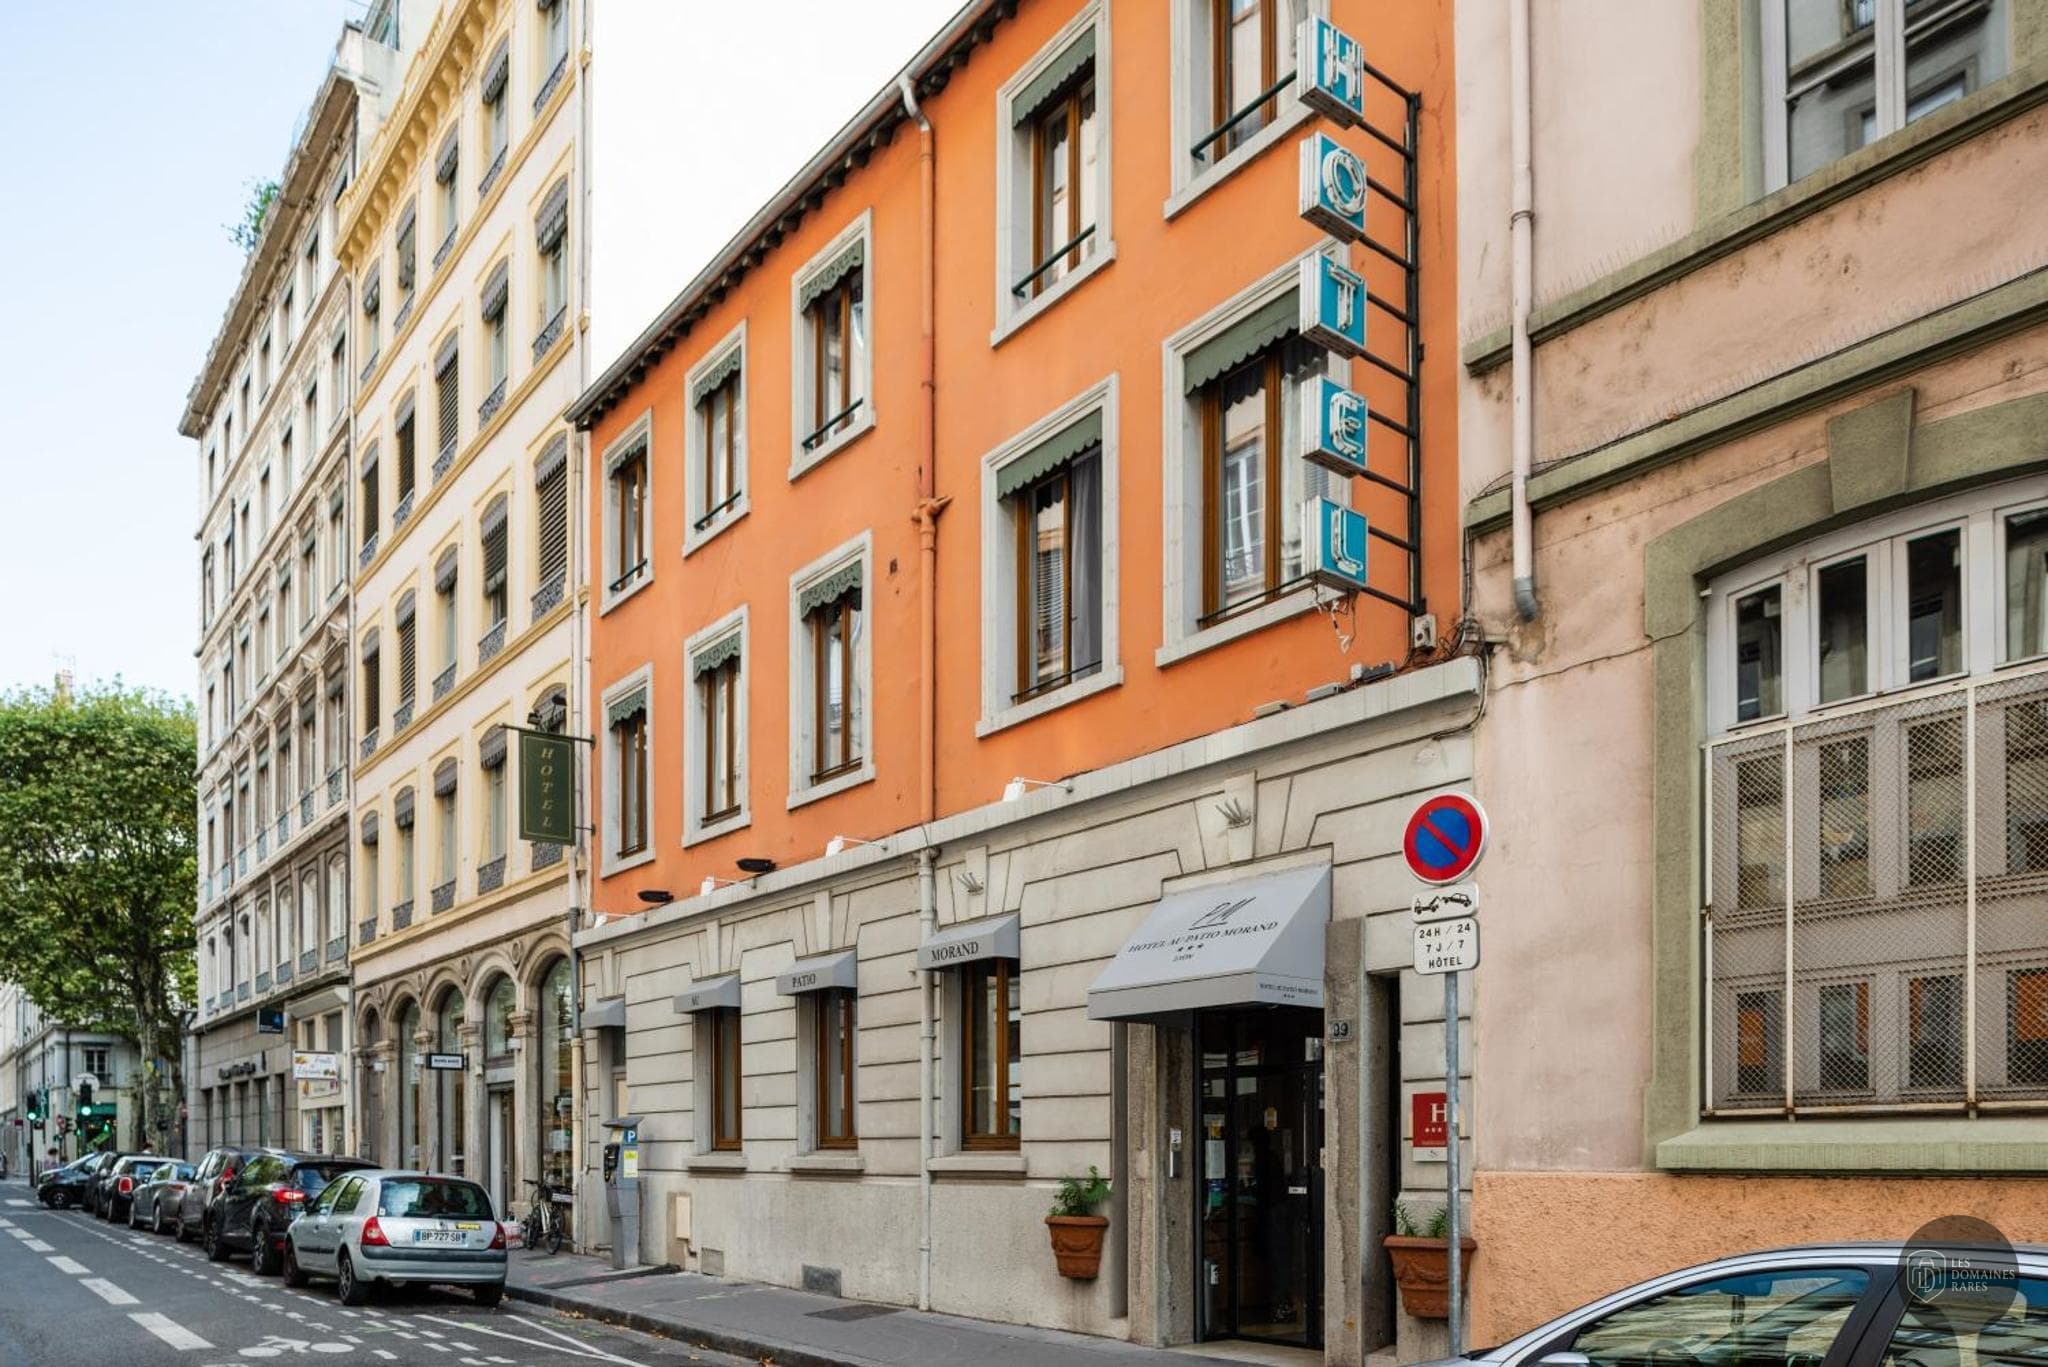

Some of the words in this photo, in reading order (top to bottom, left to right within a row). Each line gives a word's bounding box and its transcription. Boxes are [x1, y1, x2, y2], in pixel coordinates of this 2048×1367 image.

[1322, 26, 1366, 577] HOTEL
[541, 747, 554, 828] HOTEL
[1224, 921, 1279, 937] MORAND
[1457, 923, 1471, 934] 24
[931, 941, 979, 963] MORAND
[1428, 956, 1463, 969] HÔTEL
[792, 973, 816, 988] PATIO
